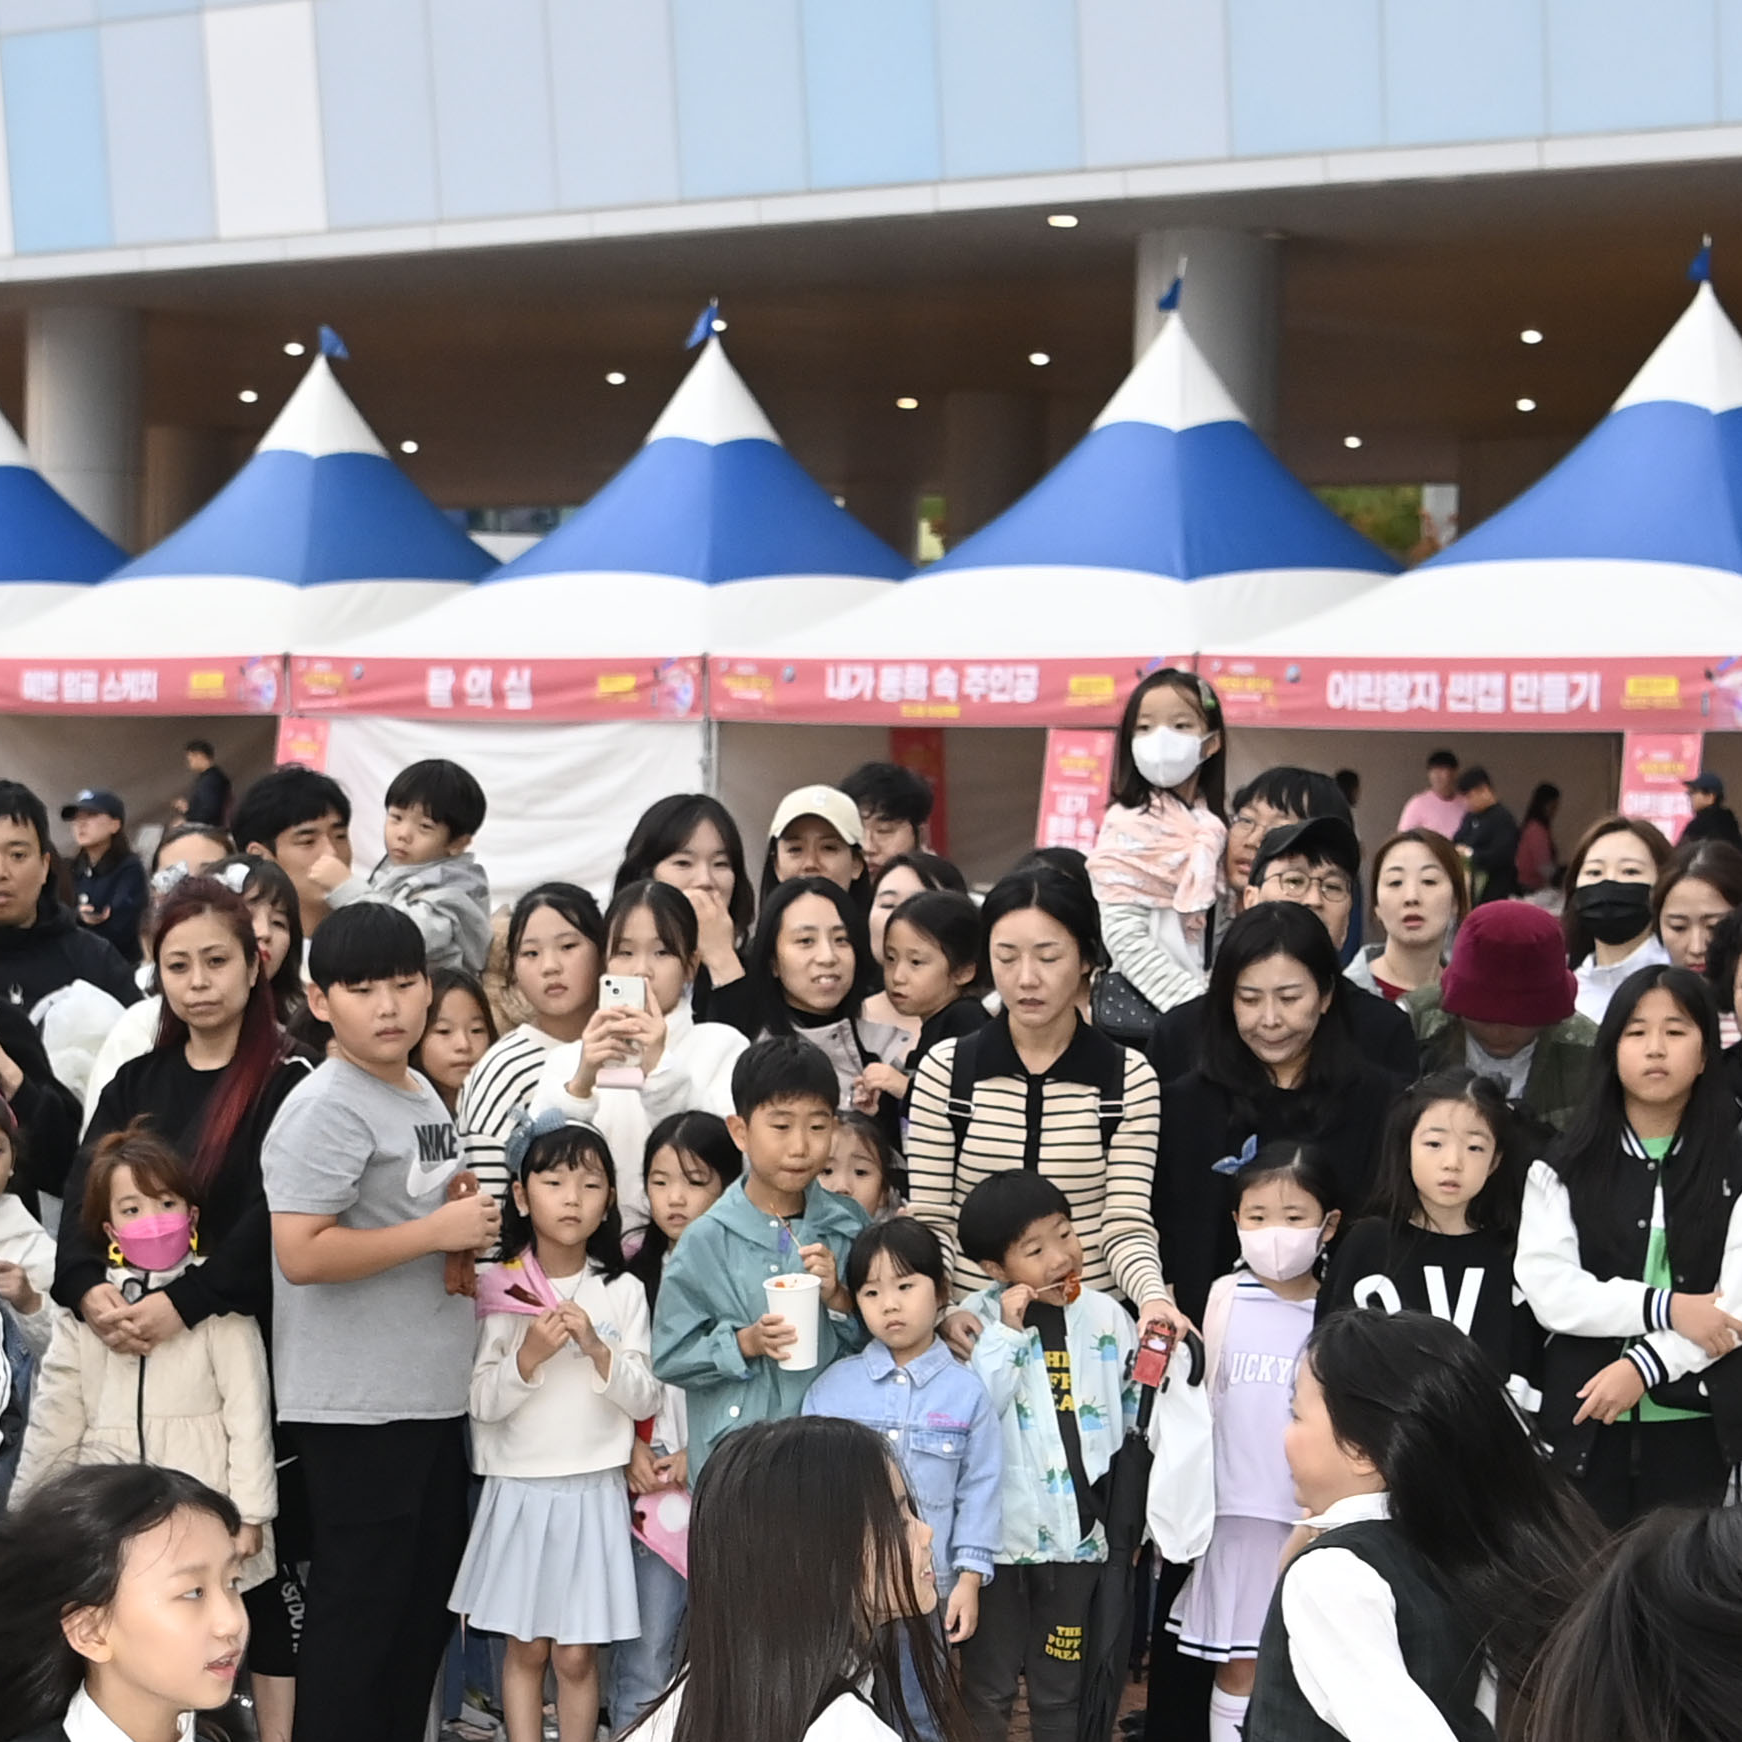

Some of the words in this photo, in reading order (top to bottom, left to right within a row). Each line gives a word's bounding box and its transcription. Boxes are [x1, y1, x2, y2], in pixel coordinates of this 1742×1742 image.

[825, 664, 876, 701] 내가
[932, 666, 960, 703] 속
[962, 665, 1040, 704] 주인공
[1326, 670, 1441, 712] 어린왕자
[1509, 671, 1602, 713] 만들기
[413, 1122, 459, 1162] NIKE
